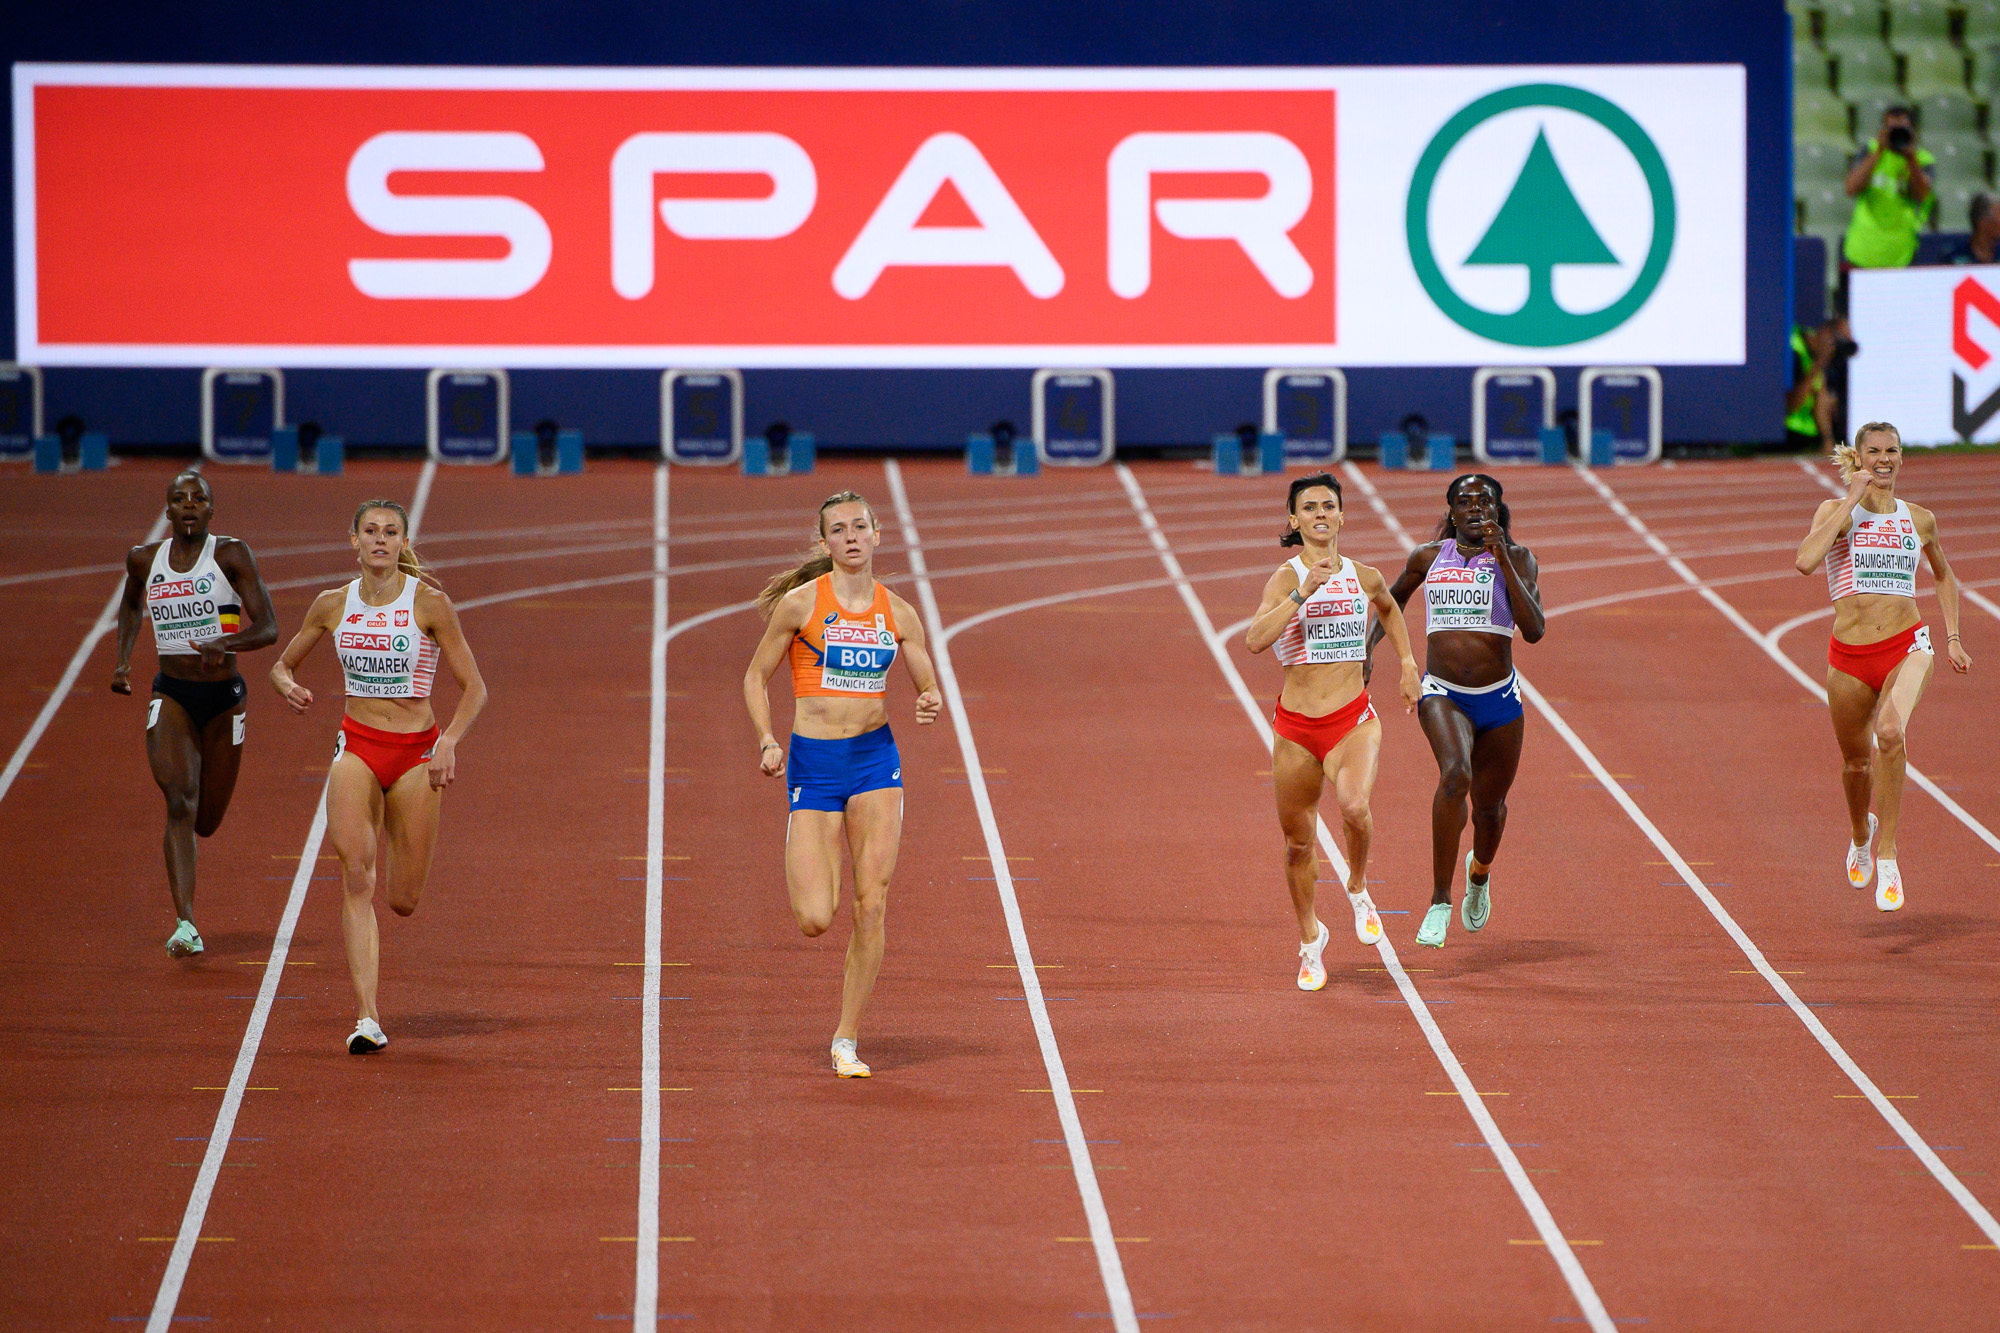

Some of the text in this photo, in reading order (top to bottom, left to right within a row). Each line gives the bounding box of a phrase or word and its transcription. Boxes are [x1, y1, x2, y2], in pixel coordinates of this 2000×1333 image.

[346, 131, 1314, 299] SPAR
[1855, 534, 1901, 547] SPAR
[1428, 570, 1474, 582] SPAR
[149, 582, 194, 598] SPAR
[1857, 580, 1894, 588] MUNICH
[1428, 589, 1490, 605] OHURUOGU
[151, 600, 215, 621] BOLINGO
[1307, 602, 1353, 616] SPAR
[1432, 616, 1487, 625] MUNICH 2022
[157, 625, 218, 641] MUNICH 2022
[828, 628, 878, 642] SPAR
[341, 634, 390, 649] SPAR
[841, 649, 882, 668] BOL
[1311, 650, 1348, 660] MUNICH
[341, 654, 410, 673] KACZMAREK
[348, 680, 409, 695] MUNICH 2022
[826, 676, 866, 688] MUNICH
